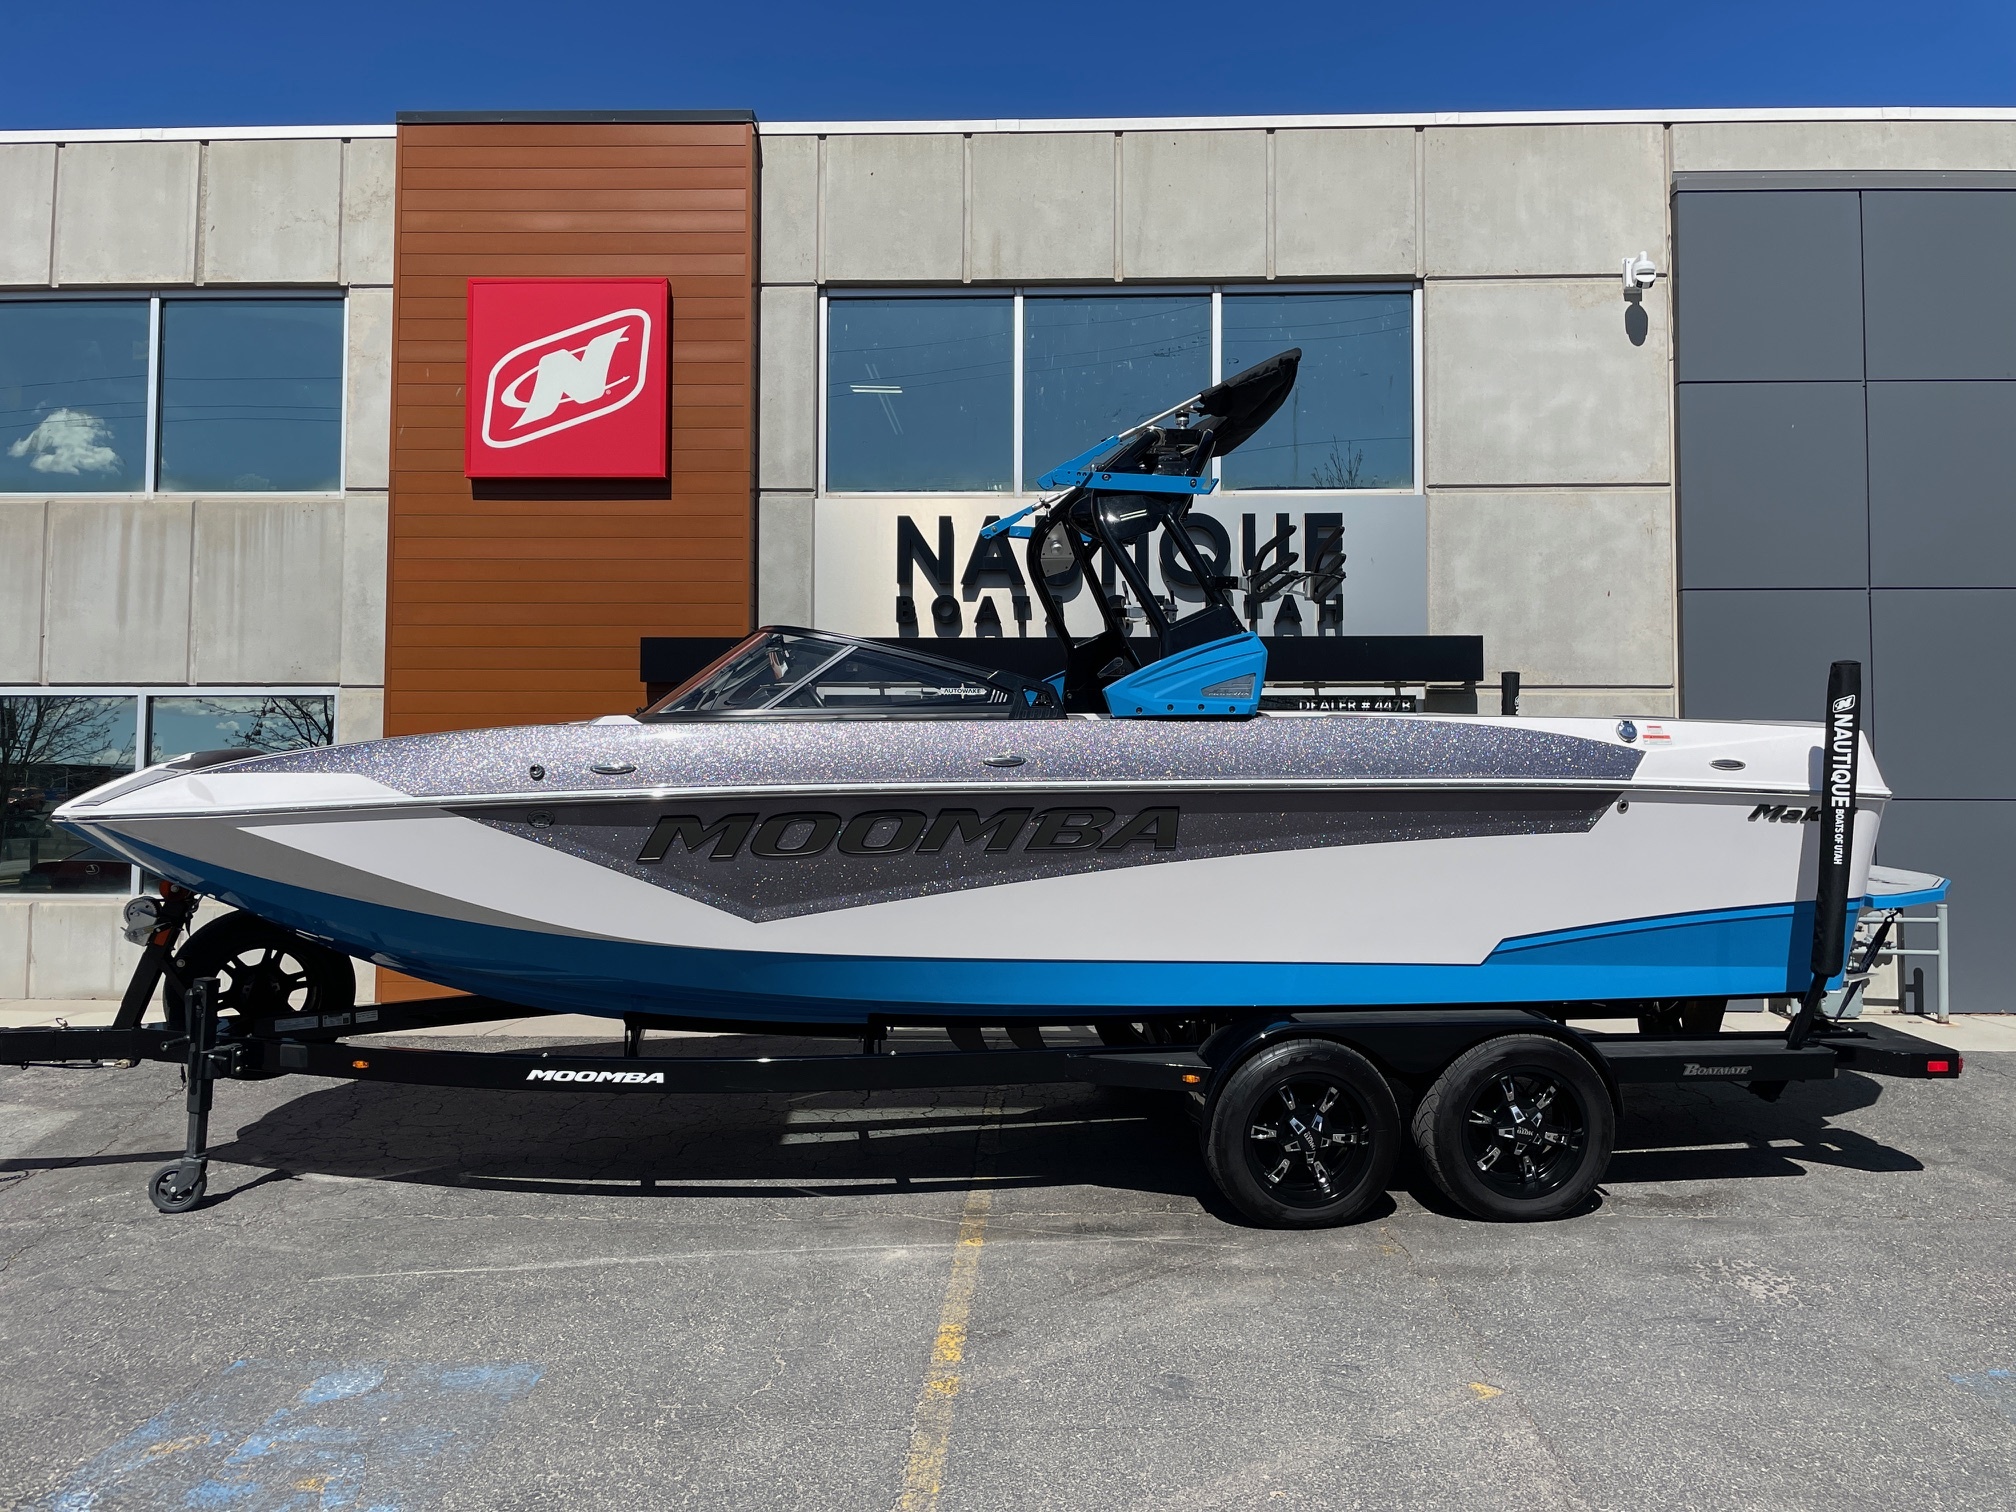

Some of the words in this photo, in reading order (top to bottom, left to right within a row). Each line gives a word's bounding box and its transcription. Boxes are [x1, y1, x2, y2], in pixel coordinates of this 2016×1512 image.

[1299, 699, 1356, 711] DEALER
[1361, 699, 1371, 711] #
[1831, 714, 1854, 808] NAUTIQUE
[1834, 809, 1845, 833] BOATS
[637, 805, 1180, 863] MOOMBA
[1834, 834, 1843, 844] OF
[1833, 845, 1843, 864] UTAH
[525, 1069, 665, 1084] MOOMBA
